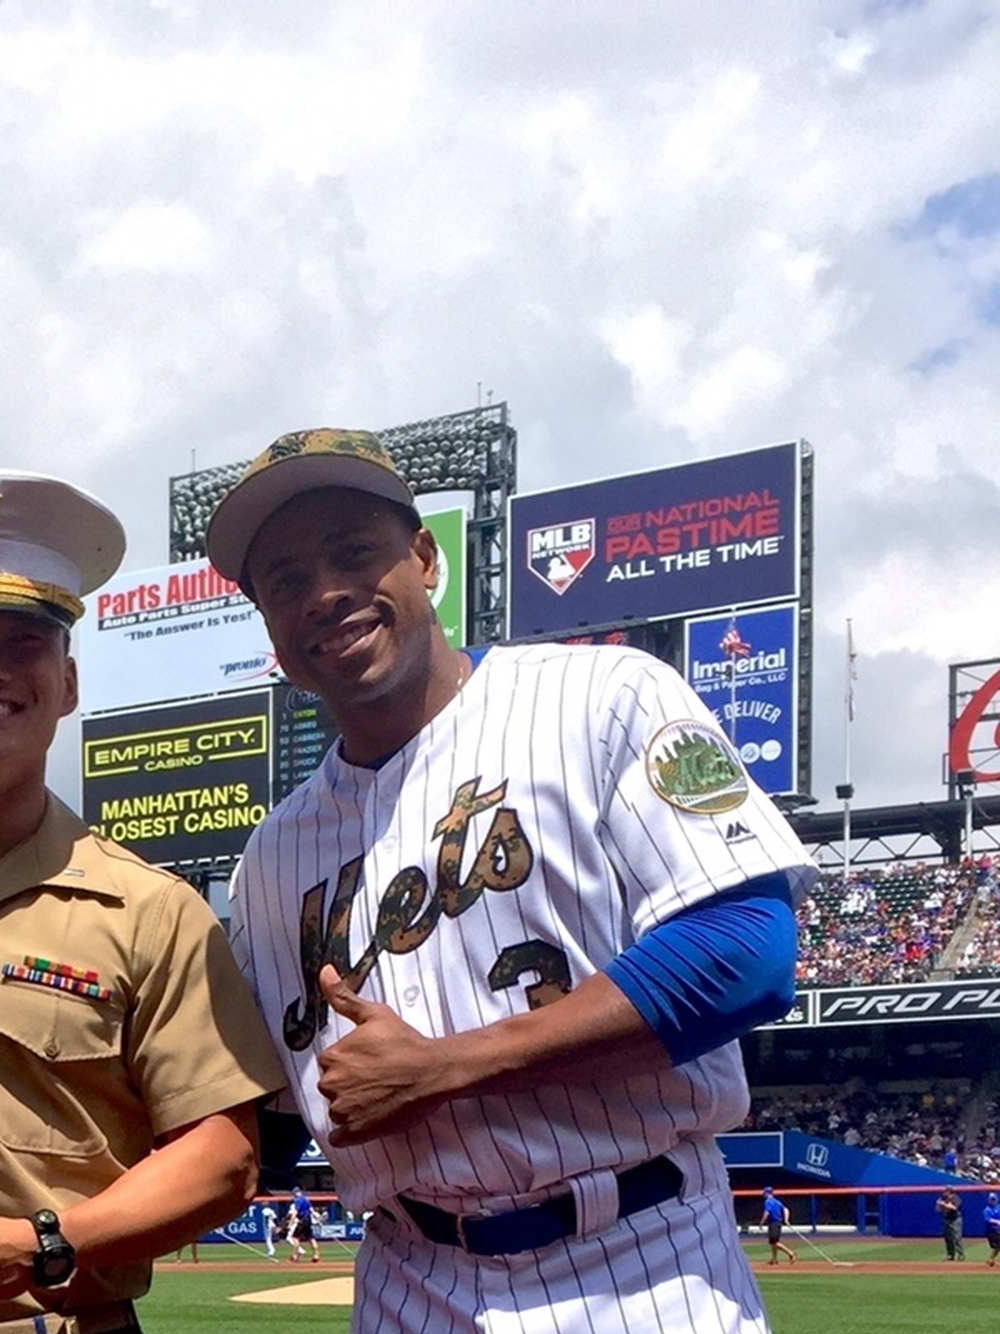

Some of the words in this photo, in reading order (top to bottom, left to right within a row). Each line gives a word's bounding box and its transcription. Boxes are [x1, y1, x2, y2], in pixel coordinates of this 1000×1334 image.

[645, 489, 780, 524] NATIONAL
[532, 523, 591, 552] MLB
[605, 508, 779, 563] PASTIME
[606, 560, 655, 582] ALL
[659, 549, 711, 573] THE
[716, 536, 780, 564] TIME
[97, 582, 161, 618] Parts
[103, 614, 137, 630] Auto
[139, 607, 178, 622] Parts
[182, 599, 224, 616] Super
[155, 619, 204, 637] Answer
[207, 617, 220, 627] Is
[767, 672, 786, 683] LLC
[723, 700, 782, 724] DELIVER
[94, 739, 190, 766] EMPIRE
[144, 754, 203, 771] CASINO
[102, 783, 249, 820] MANHATTAN'S
[184, 805, 266, 834] CASINO
[283, 775, 534, 1051] Mets
[822, 992, 941, 1017] PRO
[228, 1221, 257, 1234] GAS
